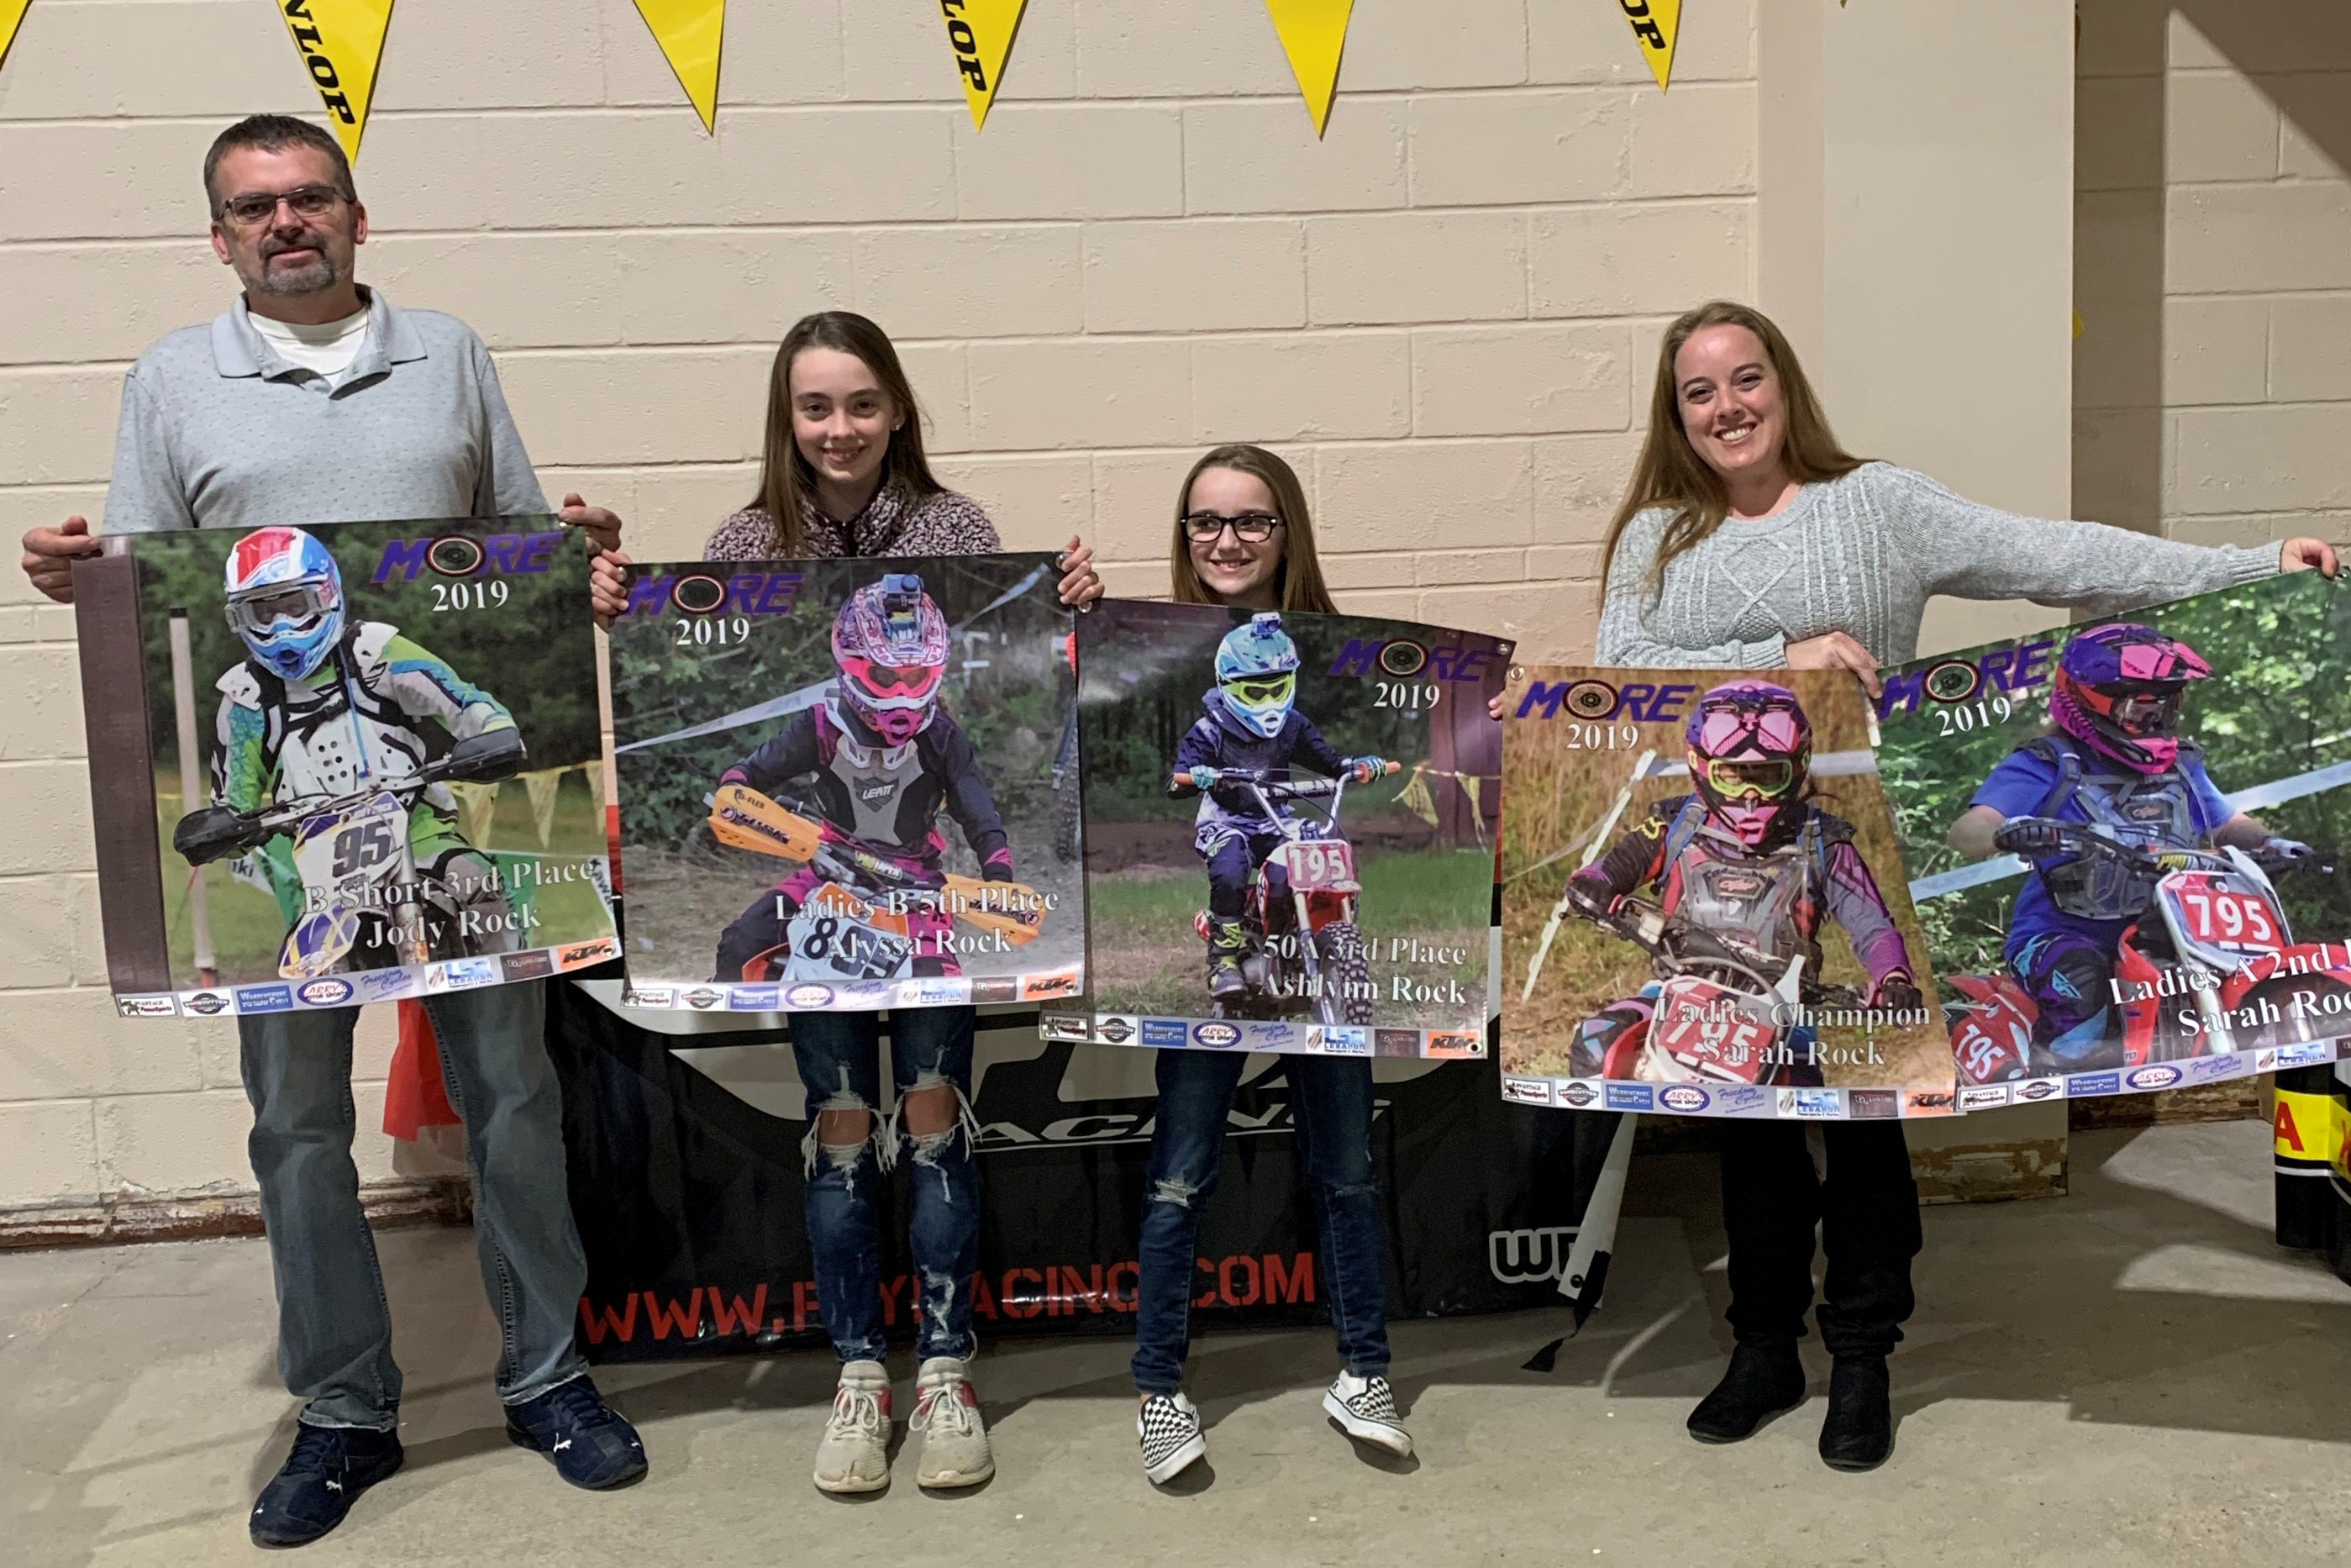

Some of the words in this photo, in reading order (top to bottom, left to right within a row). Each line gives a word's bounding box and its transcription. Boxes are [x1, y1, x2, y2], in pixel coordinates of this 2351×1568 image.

[370, 531, 565, 584] MORE
[430, 580, 509, 612] 2019
[618, 572, 806, 618] MORE
[676, 617, 750, 645] 2019
[1327, 638, 1501, 682] MORE
[1373, 681, 1440, 710] 2019
[1877, 639, 2054, 722] MORE
[1515, 679, 1696, 723] MORE
[1934, 696, 2012, 737] 2019
[1566, 723, 1638, 750] 2019
[332, 818, 394, 879] 95
[1288, 849, 1345, 882] 195
[304, 885, 329, 913] B
[339, 880, 432, 910] Short
[444, 866, 498, 897] 3rd
[512, 860, 593, 889] Place
[776, 892, 876, 920] Ladies
[888, 891, 909, 917] B
[921, 889, 968, 916] 5th
[977, 887, 1060, 913] Place
[366, 916, 447, 949] Jody
[459, 903, 542, 937] Rock
[2185, 895, 2271, 941] 795
[824, 933, 923, 965] Alyssa
[935, 927, 1013, 955] Rock
[1328, 936, 1379, 961] 3rd
[1390, 937, 1466, 966] Place
[1391, 976, 1466, 1004] Rock
[2109, 967, 2222, 1005] Ladies
[2233, 955, 2259, 986] A
[2265, 943, 2333, 979] 2nd
[1655, 997, 1759, 1025] Ladies
[1770, 1001, 1931, 1034] Champion
[2178, 997, 2281, 1037] Sarah
[1702, 1036, 1795, 1067] Sarah
[1808, 1039, 1886, 1067] Rock
[1955, 1023, 2007, 1080] 795
